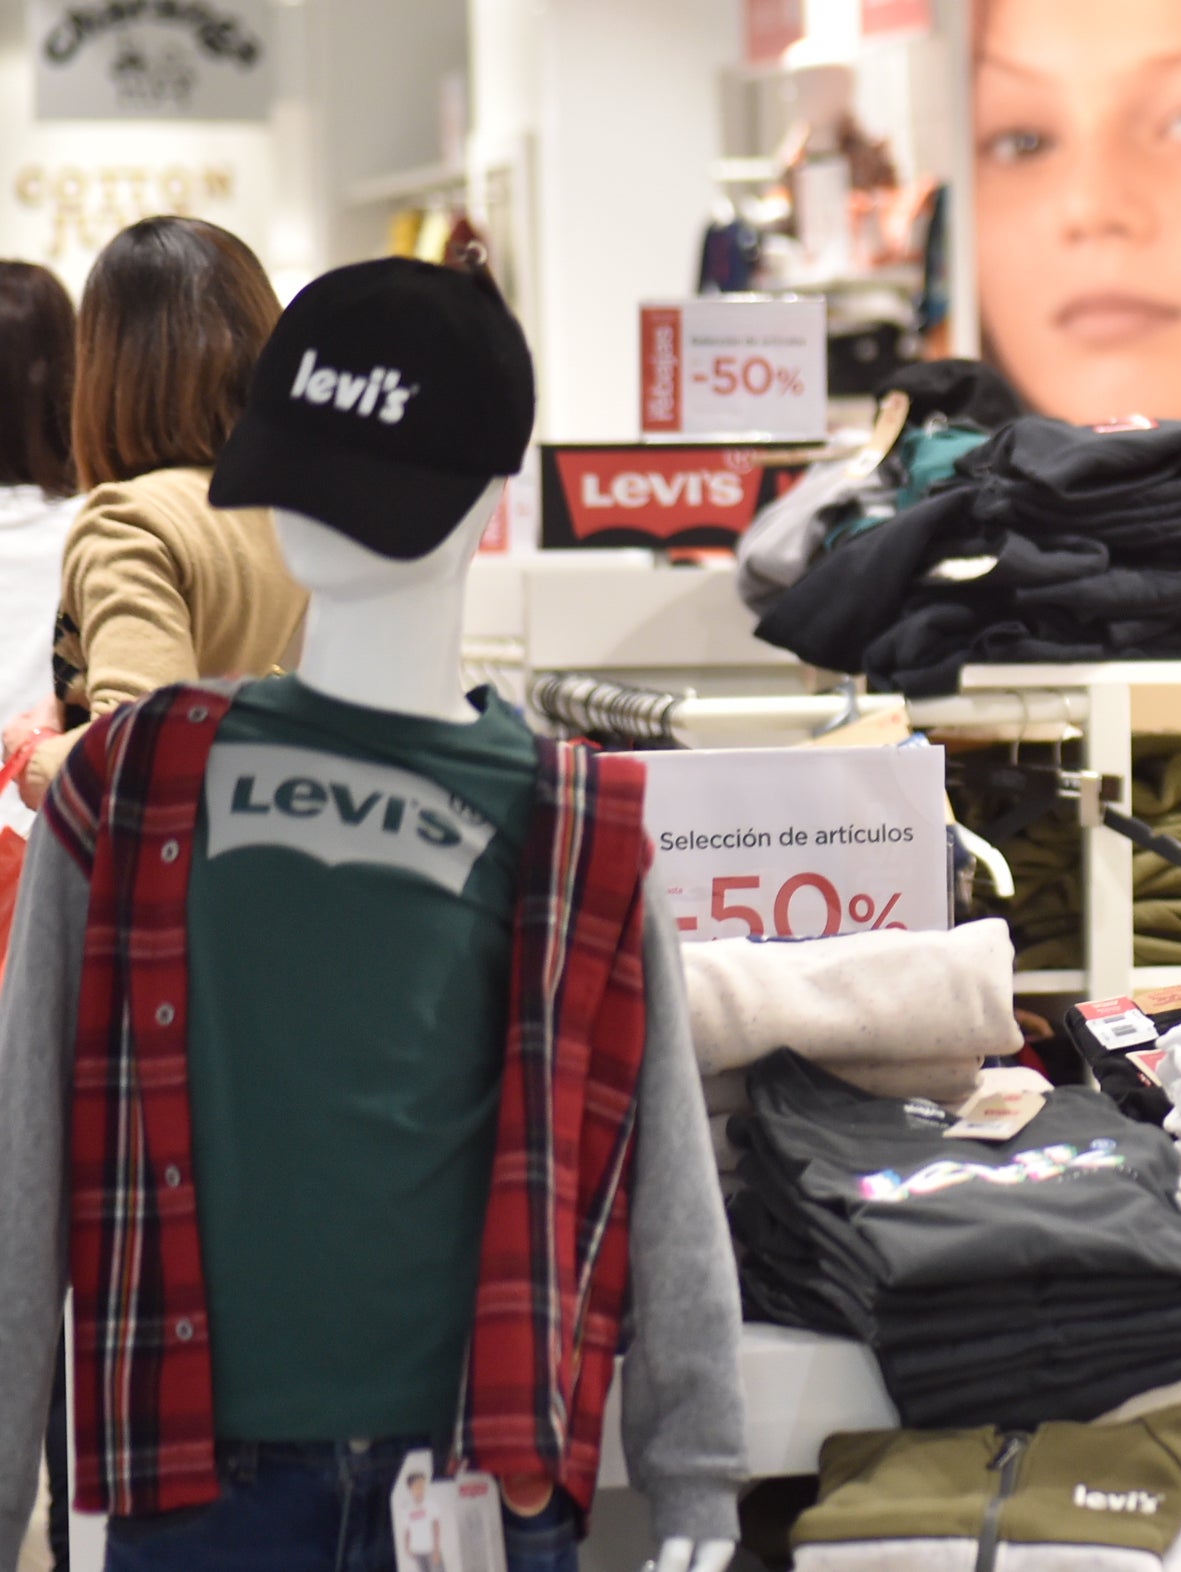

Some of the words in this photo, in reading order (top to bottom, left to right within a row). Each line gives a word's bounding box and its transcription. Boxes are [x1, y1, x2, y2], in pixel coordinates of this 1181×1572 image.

[290, 348, 411, 424] levi's
[692, 356, 805, 395] -50%
[660, 828, 772, 851] Selección
[779, 827, 808, 847] de
[815, 824, 914, 845] artículos
[676, 872, 909, 941] -50%
[1074, 1483, 1158, 1516] levi's
